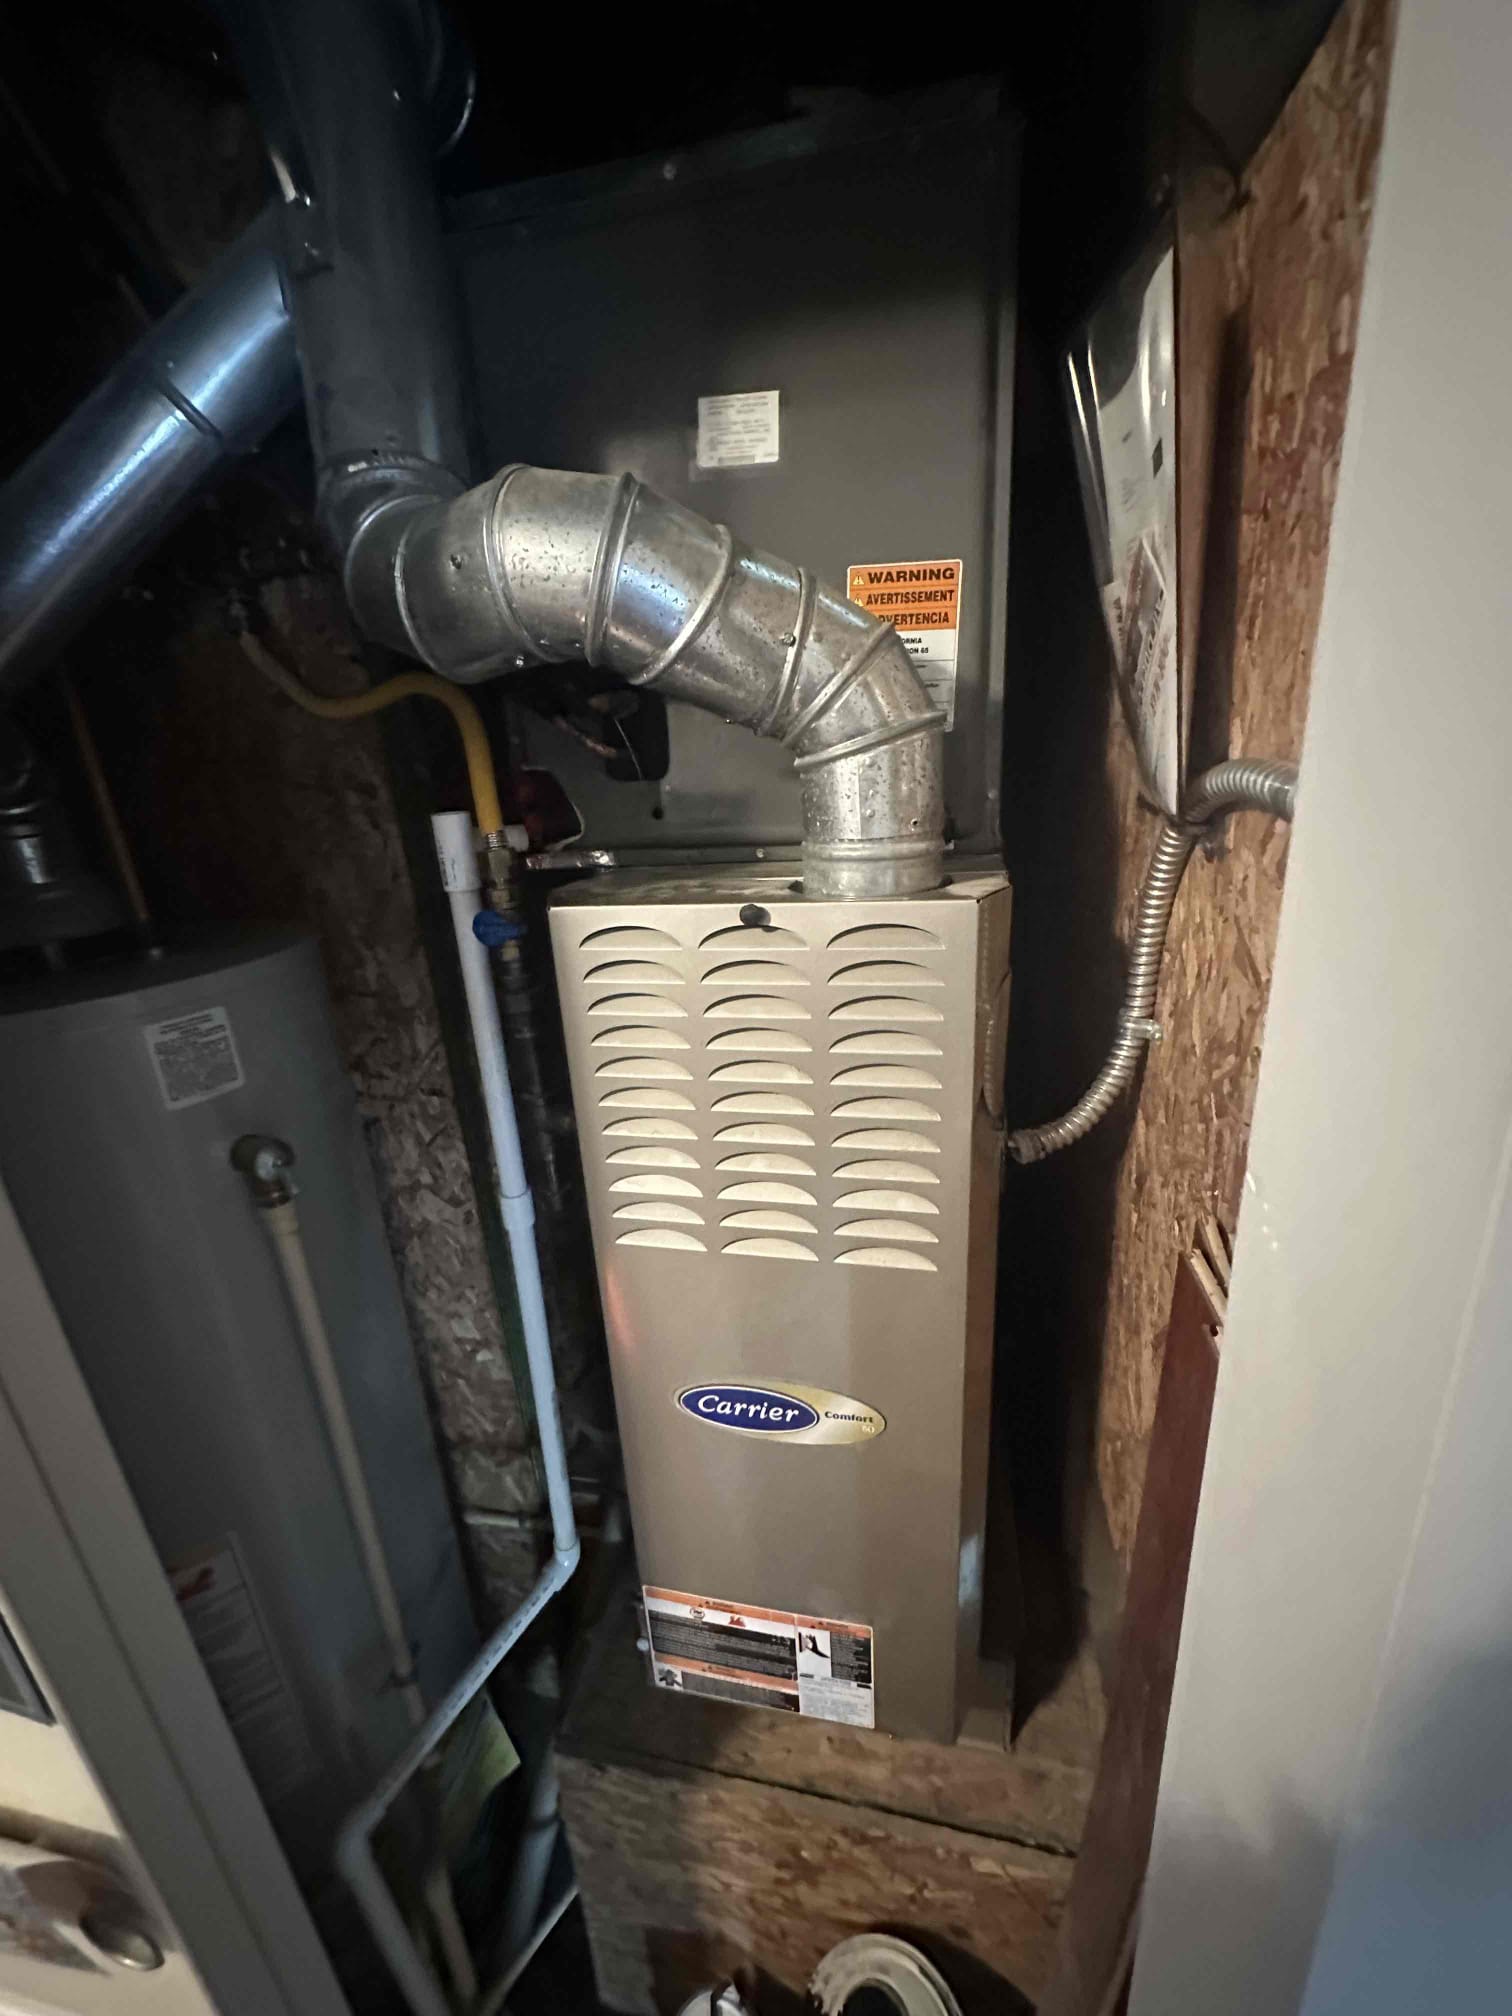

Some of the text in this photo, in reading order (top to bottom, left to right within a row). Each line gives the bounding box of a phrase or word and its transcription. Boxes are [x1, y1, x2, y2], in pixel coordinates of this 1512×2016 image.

[868, 568, 954, 584] WARNING
[866, 590, 954, 605] AVERTISSEMENT
[878, 612, 949, 625] DVERTENCIA
[698, 1394, 874, 1423] Carrier Comfort
